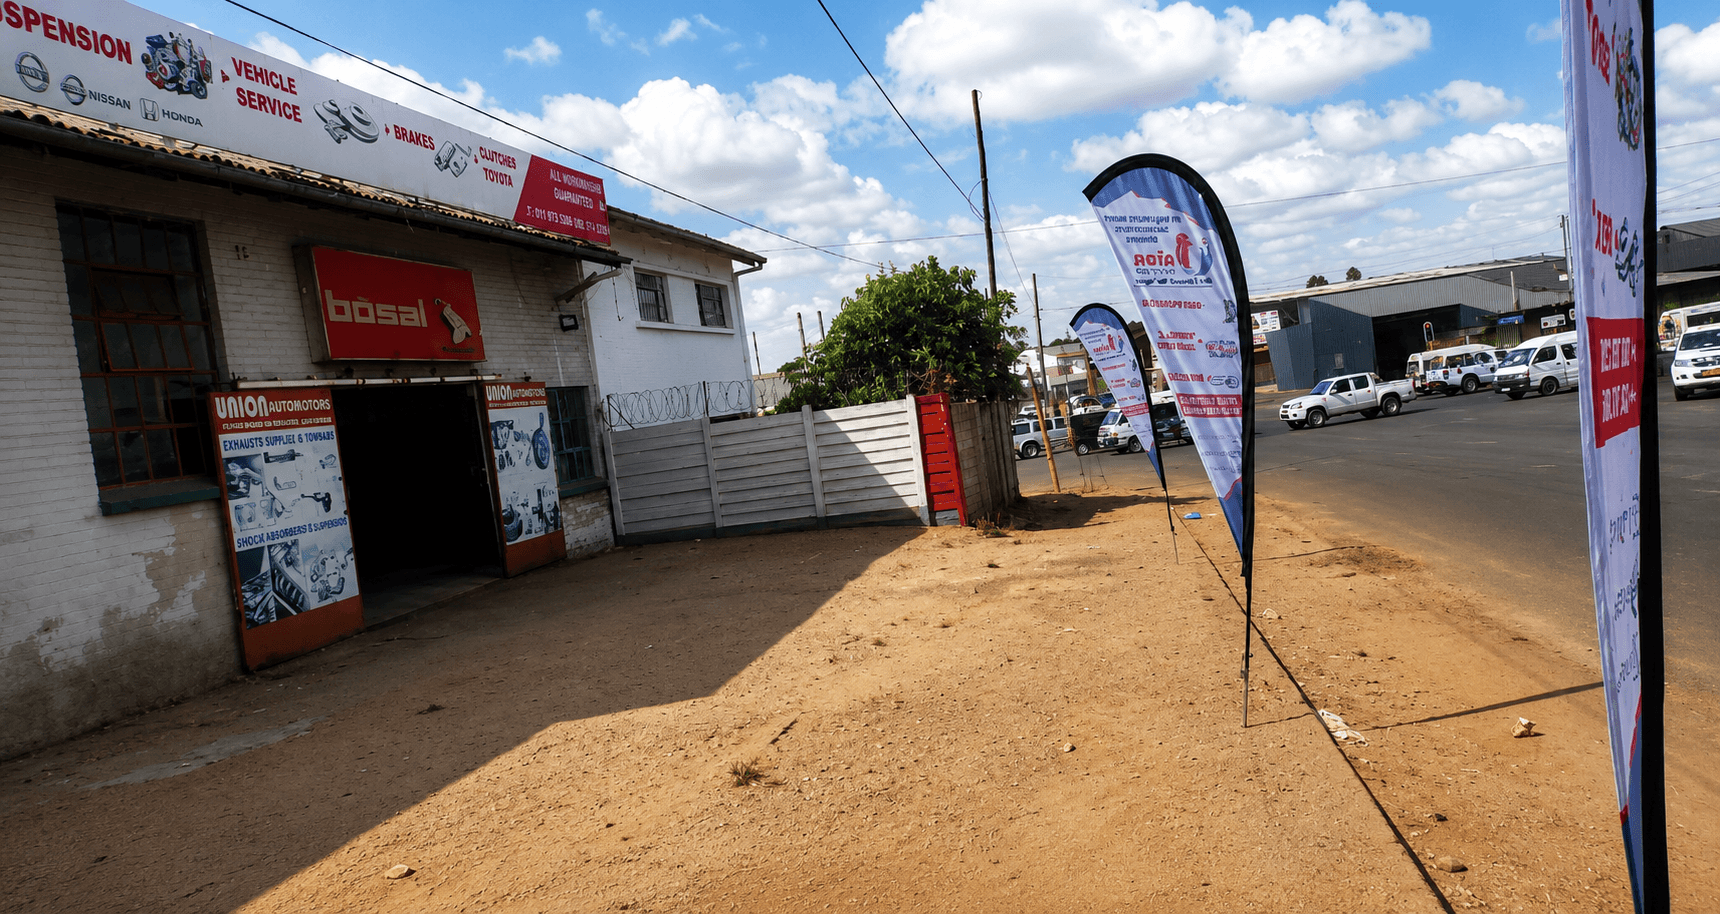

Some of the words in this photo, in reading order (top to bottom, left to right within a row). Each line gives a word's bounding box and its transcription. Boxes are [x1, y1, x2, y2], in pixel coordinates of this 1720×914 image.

[0, 0, 133, 65] SPENSION
[231, 57, 297, 96] VEHICLE
[88, 89, 131, 111] NISSAN
[236, 86, 302, 123] SERVICE
[161, 108, 203, 127] HONDA
[393, 124, 435, 150] BRAKES
[479, 146, 517, 170] CLUTCHES
[483, 167, 514, 188] TOYOTA
[485, 385, 513, 401] UNION
[215, 395, 269, 419] UNION
[268, 398, 331, 413] AUTOMOTORS
[223, 437, 264, 452] EXHAUSTS
[236, 533, 265, 549] SHOCK
